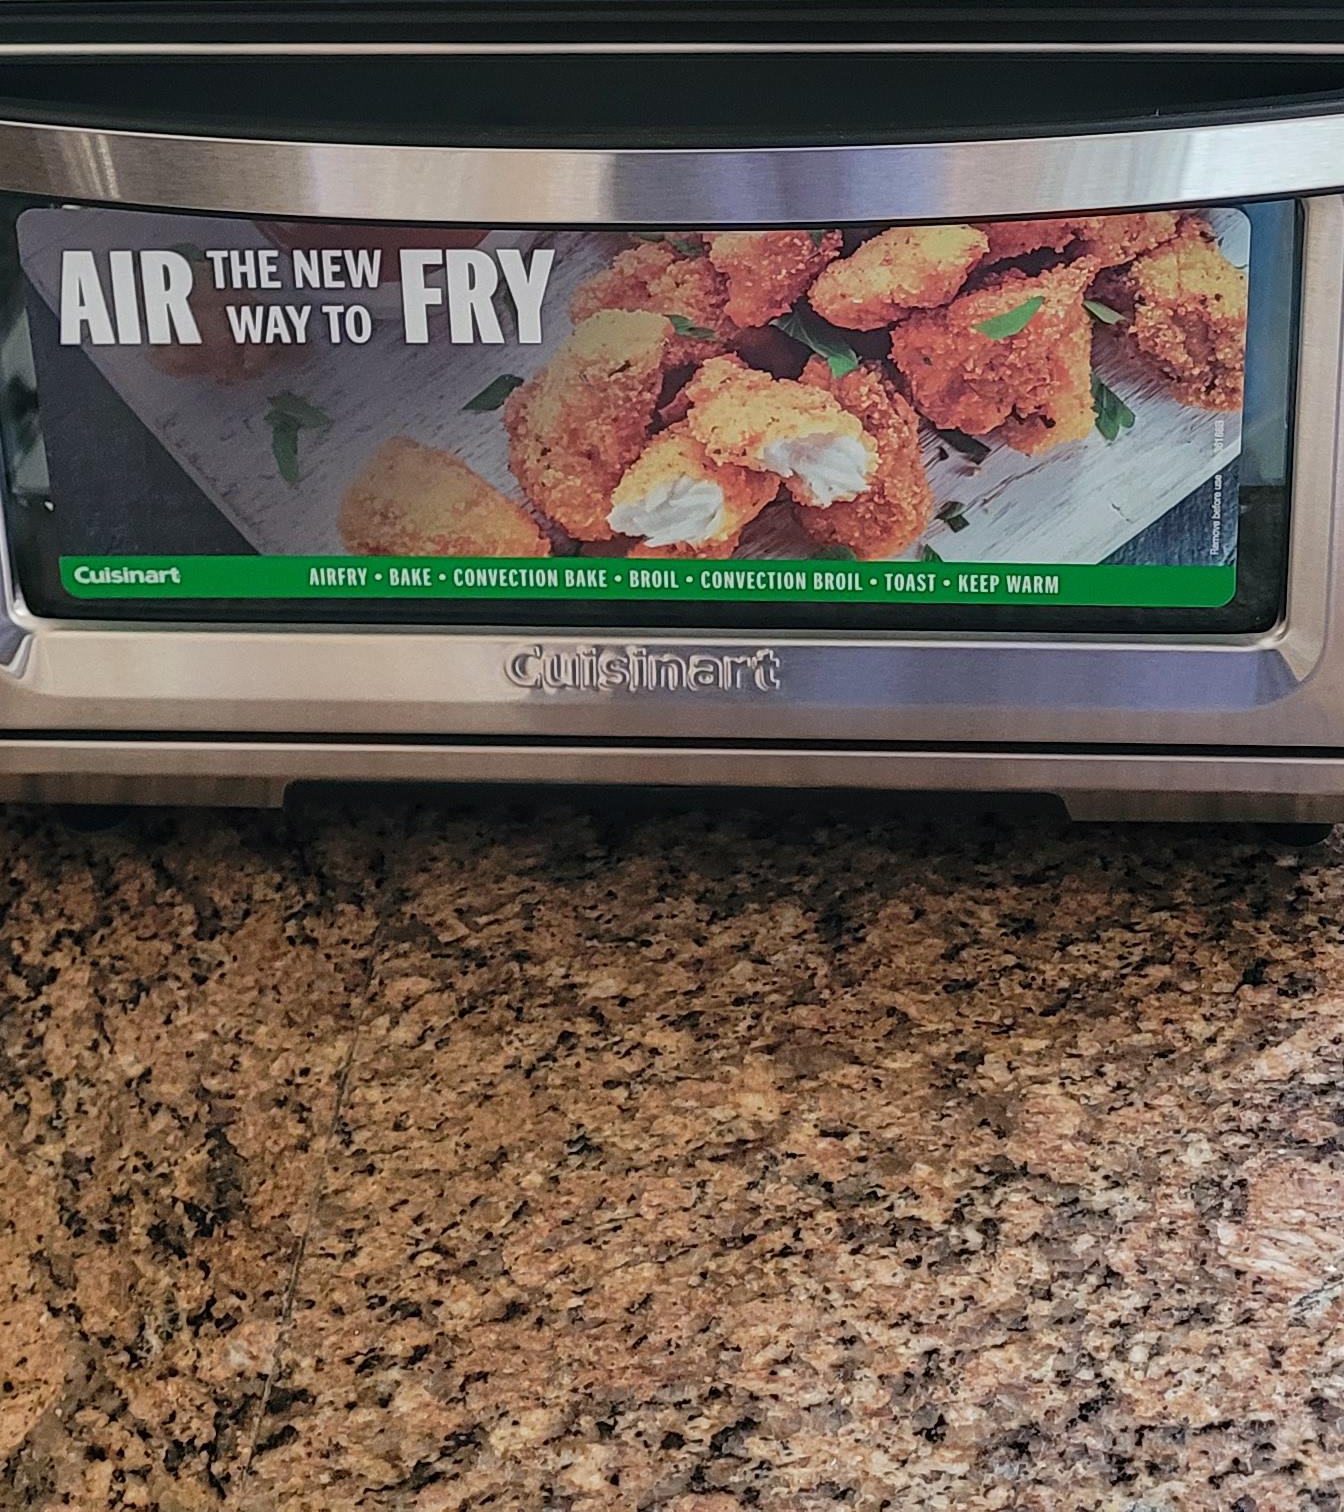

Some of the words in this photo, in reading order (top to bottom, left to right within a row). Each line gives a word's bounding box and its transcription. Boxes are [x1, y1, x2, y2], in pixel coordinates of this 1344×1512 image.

[206, 250, 282, 289] THE
[293, 249, 382, 288] NEW
[60, 250, 202, 345] AIR
[399, 249, 556, 345] FRY
[226, 305, 312, 345] WAY
[321, 305, 372, 345] TO
[1214, 474, 1223, 491] use
[1211, 491, 1223, 519] before
[1210, 520, 1223, 555] Remove
[73, 565, 182, 586] Cuisinart
[309, 567, 368, 587] AIRFRY
[388, 568, 433, 587] BAKE
[453, 569, 559, 588] CONVECTION
[564, 569, 608, 588] BAKE
[629, 570, 679, 589] BROIL
[700, 571, 807, 591] CONVECTION
[812, 573, 863, 592] BROIL
[884, 573, 937, 593] TOAST
[958, 574, 1000, 594] KEEP
[1006, 575, 1060, 595] WARM
[503, 643, 783, 692] Cuisinart
